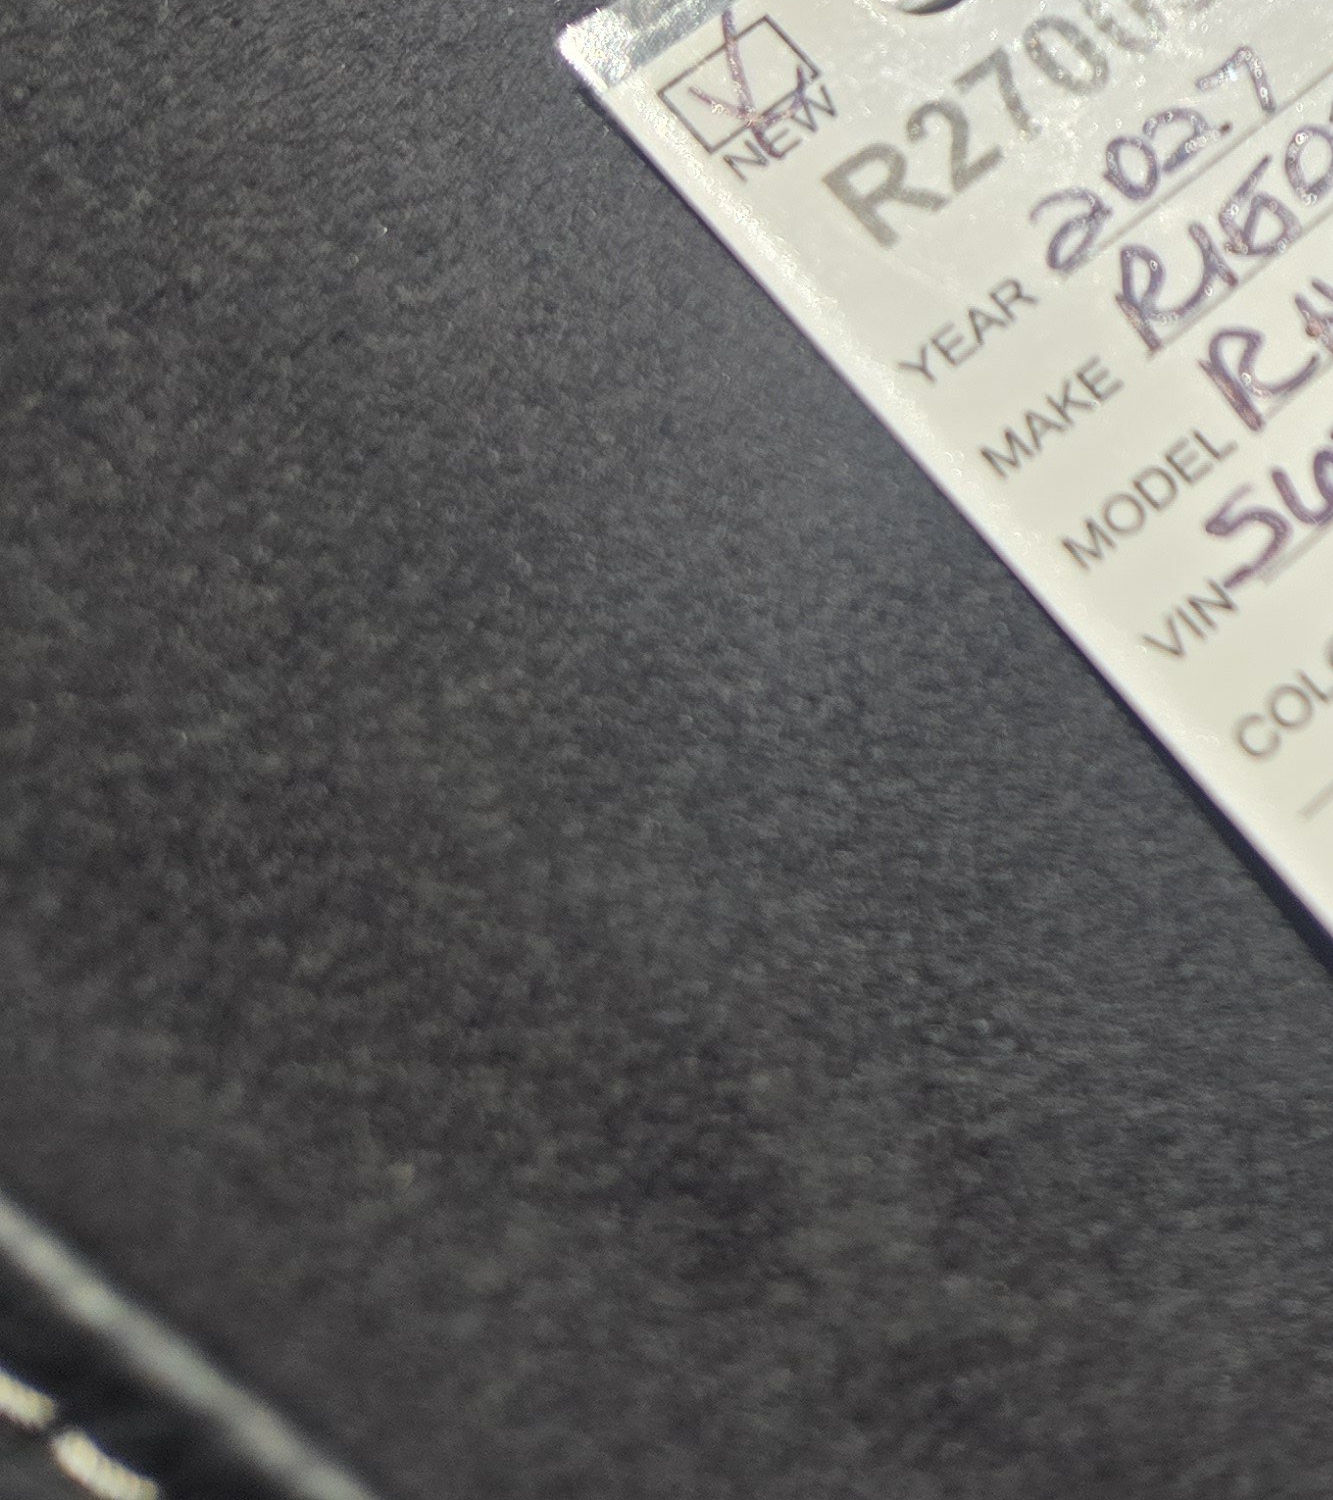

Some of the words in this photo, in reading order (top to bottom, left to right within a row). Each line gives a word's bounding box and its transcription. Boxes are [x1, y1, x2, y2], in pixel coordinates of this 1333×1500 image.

[724, 87, 840, 183] NEW
[896, 274, 1043, 389] YEAR
[978, 354, 1125, 481] MAKE
[1059, 419, 1240, 570] MODEL
[1142, 578, 1237, 662] VIN
